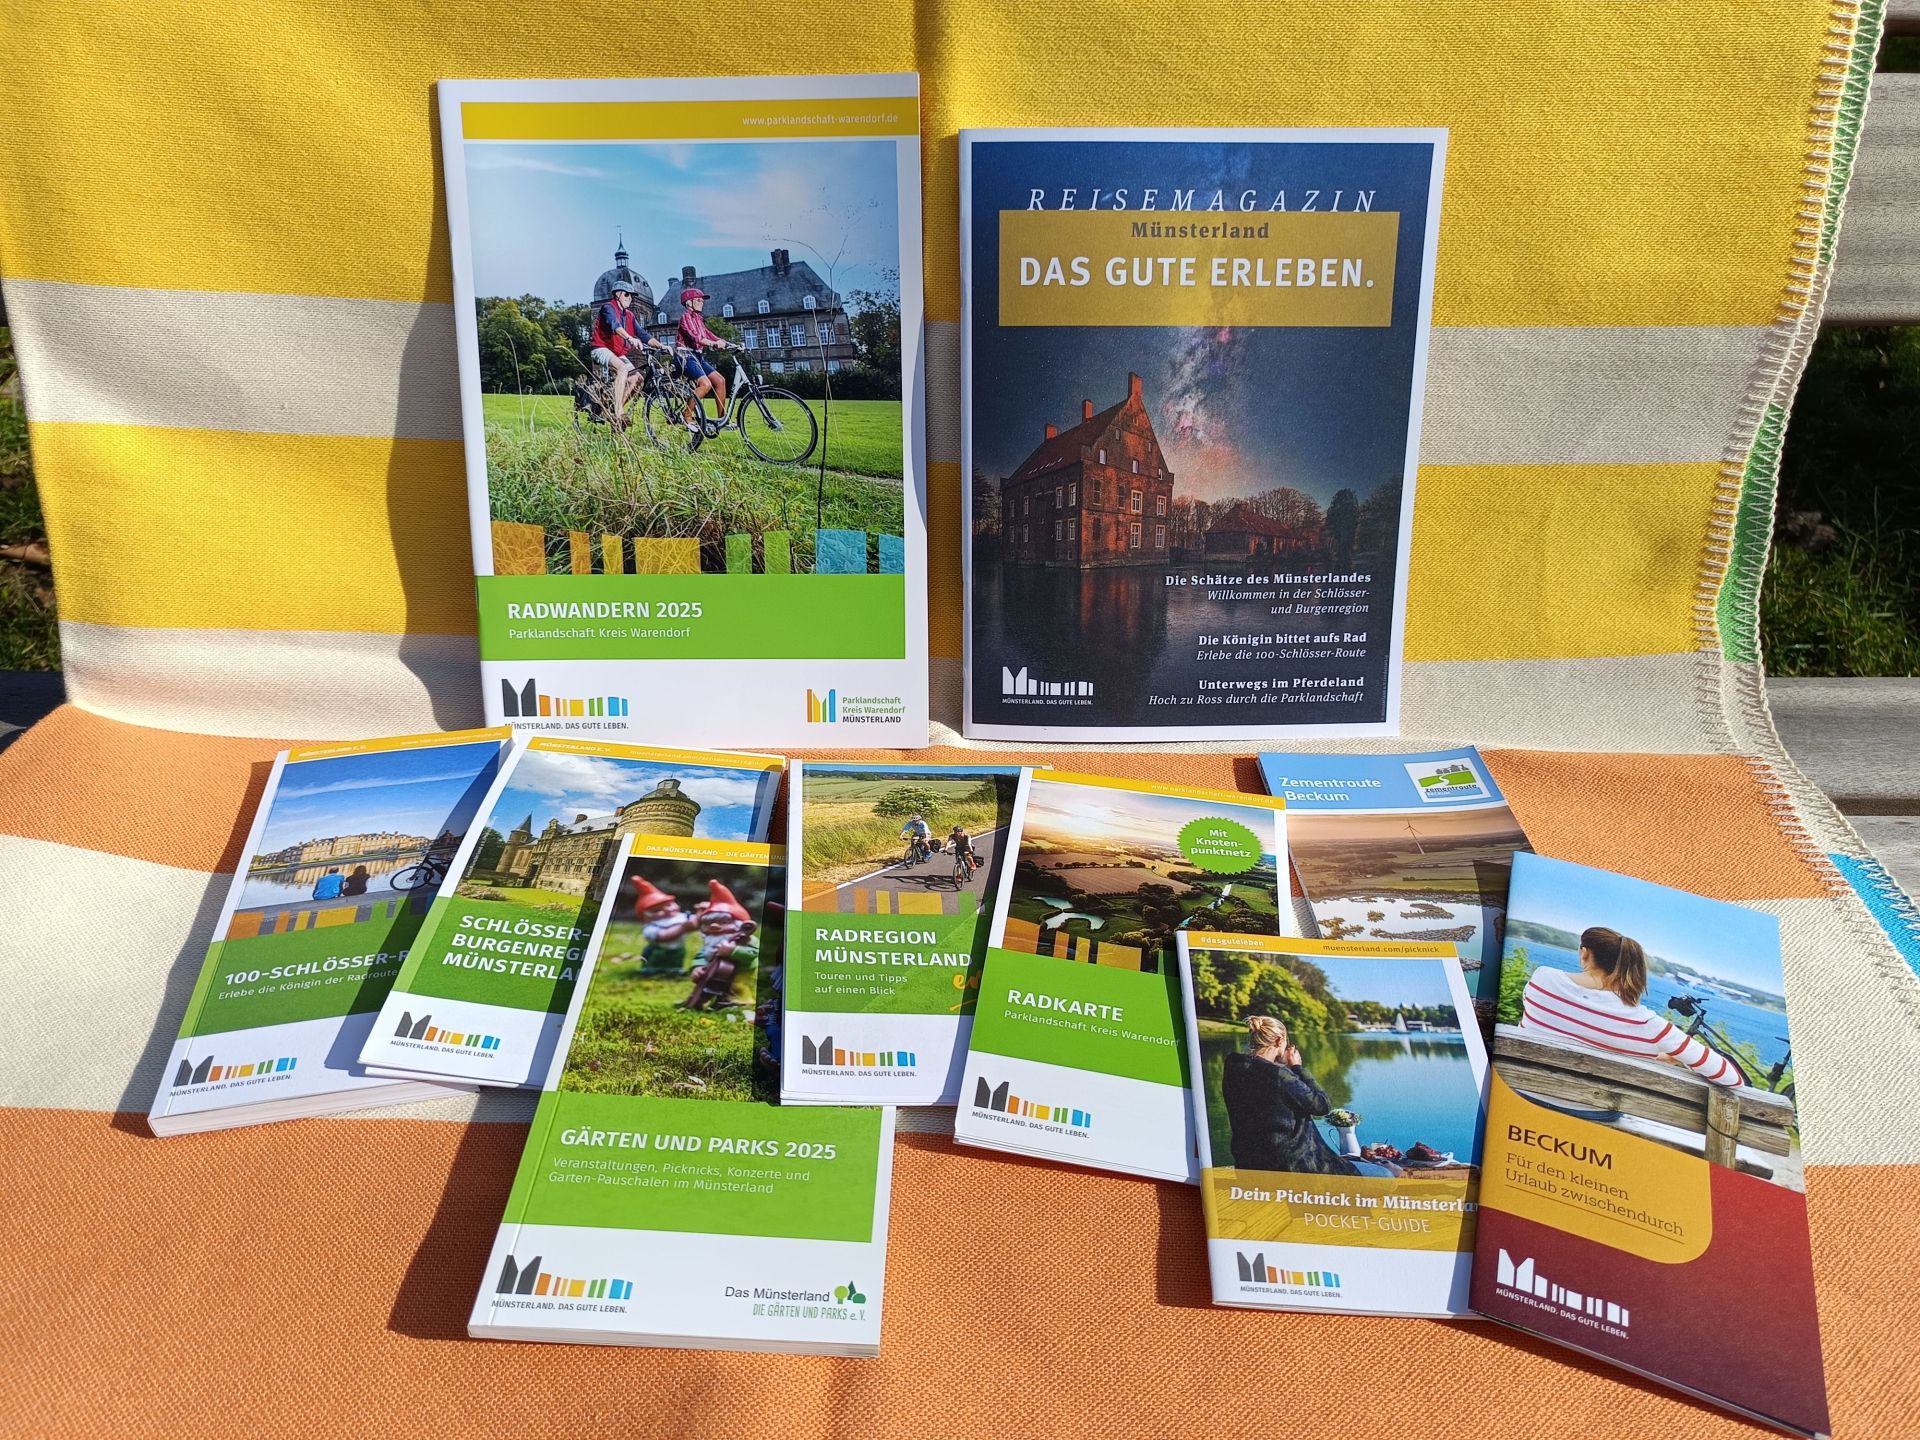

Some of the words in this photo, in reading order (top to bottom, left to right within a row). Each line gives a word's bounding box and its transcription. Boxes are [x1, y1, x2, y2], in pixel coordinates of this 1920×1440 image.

[742, 114, 898, 127] www.parklandschaft-warendorf.de
[1026, 188, 1376, 213] REISEMAGAZIN
[1131, 221, 1269, 239] Münsterland
[1020, 256, 1090, 287] DAS
[1105, 256, 1196, 287] GUTE
[1211, 257, 1374, 288] ERLEBEN.
[1165, 575, 1187, 586] Die
[1191, 574, 1243, 585] Schätze
[1247, 573, 1269, 584] des
[1273, 572, 1371, 584] Münsterlandes
[1207, 590, 1276, 600] Willkommen
[1279, 590, 1290, 600] in
[1293, 589, 1312, 599] der
[1315, 588, 1370, 599] Schlösser-
[508, 602, 650, 619] RADWANDERN
[656, 602, 703, 618] 2025
[1271, 604, 1292, 614] und
[1295, 603, 1369, 615] Burgenregion
[509, 627, 595, 639] Parklandschaft
[599, 628, 627, 638] Kreis
[631, 627, 691, 638] Warendorf
[1199, 635, 1219, 645] Die
[1222, 634, 1272, 647] Königin
[1276, 633, 1310, 644] bittet
[1313, 632, 1340, 643] aufs
[1343, 632, 1367, 642] Rad
[1196, 650, 1232, 661] Erlebe
[1235, 650, 1252, 660] die
[1255, 648, 1366, 659] 100-Schlösser-Route
[1199, 679, 1268, 690] Unterwegs
[1272, 678, 1289, 688] im
[1293, 677, 1364, 688] Pferdeland
[842, 697, 902, 705] Parklandschaft
[1002, 697, 1045, 705] MÜNSTERLAND.
[1149, 694, 1177, 705] Hoch
[1180, 696, 1193, 704] zu
[1196, 694, 1222, 704] Ross
[1225, 693, 1257, 704] durch
[1260, 693, 1277, 703] die
[1281, 691, 1364, 703] Parklandschaft
[842, 706, 863, 714] Kreis
[864, 705, 906, 714] Warendorf
[565, 722, 580, 730] DAS
[582, 722, 601, 730] GUTE
[603, 722, 629, 730] LEBEN.
[842, 714, 902, 723] MÜNSTERLAND
[1279, 777, 1382, 789] Zementroute
[1424, 783, 1477, 793] zementroute
[1285, 790, 1350, 802] Beckum
[1209, 829, 1228, 838] Mit
[646, 844, 662, 852] DAS
[663, 845, 718, 856] MÜNSTERLAND
[1195, 837, 1243, 848] Knoten-
[1190, 847, 1252, 858] punktnetz
[459, 914, 591, 941] SCHLÖSSER-
[815, 928, 937, 944] RADREGION
[815, 946, 972, 967] MÜNSTERLAND
[1322, 944, 1440, 954] muensterland.com/picknick
[814, 971, 851, 981] Touren
[855, 972, 875, 981] und
[879, 973, 908, 983] Tipps
[218, 987, 255, 1001] Erlebe
[258, 984, 276, 995] die
[279, 978, 322, 993] Königin
[324, 975, 344, 986] der
[347, 969, 398, 982] Radroute
[815, 984, 832, 994] auf
[836, 985, 866, 995] einen
[869, 986, 896, 995] Blick
[1007, 988, 1124, 1023] RADKARTE
[1004, 1009, 1087, 1032] Parklandschaft
[1090, 1024, 1119, 1038] Kreis
[390, 1040, 440, 1052] MÜNSTERLAND.
[441, 1046, 455, 1054] DAS
[455, 1048, 473, 1056] GUTE
[473, 1050, 495, 1059] LEBEN.
[801, 1067, 857, 1077] MÜNSTERLAND.
[169, 1083, 228, 1098] MÜNSTERLAND.
[230, 1080, 244, 1089] DAS
[246, 1078, 266, 1087] GUTE
[267, 1074, 293, 1084] LEBEN.
[971, 1110, 1028, 1128] MÜNSTERLAND.
[1029, 1121, 1044, 1131] DAS
[1045, 1125, 1064, 1135] GUTE
[1065, 1128, 1090, 1140] LEBEN.
[560, 1125, 648, 1150] GÄRTEN
[654, 1134, 701, 1152] UND
[708, 1137, 779, 1157] PARKS
[784, 1141, 837, 1160] 2025
[1507, 1124, 1612, 1171] BECKUM
[553, 1157, 658, 1174] Veranstaltungen,
[662, 1162, 723, 1178] Picknicks,
[727, 1166, 782, 1181] Konzerte
[786, 1170, 810, 1181] und
[1506, 1152, 1534, 1170] Für
[1536, 1161, 1566, 1180] den
[1570, 1170, 1630, 1201] kleinen
[548, 1171, 670, 1188] Garten-Pauschalen
[673, 1179, 690, 1189] im
[693, 1178, 774, 1194] Münsterland
[1230, 1185, 1271, 1202] Dein
[1276, 1189, 1351, 1207] Picknick
[1355, 1192, 1377, 1208] im
[1505, 1168, 1557, 1194] Urlaub
[1561, 1188, 1685, 1237] zwischendurch
[1303, 1212, 1432, 1233] POCKET-GUIDE
[725, 1286, 750, 1298] Das
[753, 1287, 831, 1302] Münsterland
[1240, 1285, 1289, 1295] MÜNSTERLAND.
[1303, 1289, 1320, 1297] GUTE
[1321, 1290, 1343, 1299] LEBEN.
[491, 1298, 556, 1310] MÜNSTERLAND.
[558, 1302, 574, 1311] DAS
[576, 1303, 598, 1312] GUTE
[599, 1305, 628, 1314] LEBEN.
[752, 1303, 766, 1316] DIE
[767, 1302, 800, 1318] GÄRTEN
[802, 1306, 818, 1319] UND
[821, 1307, 848, 1321] PARKS
[1495, 1287, 1559, 1315] MÜNSTERLAND.
[1560, 1309, 1577, 1321] DAS
[1577, 1315, 1600, 1329] GUTE
[1601, 1323, 1630, 1341] LEBEN.
